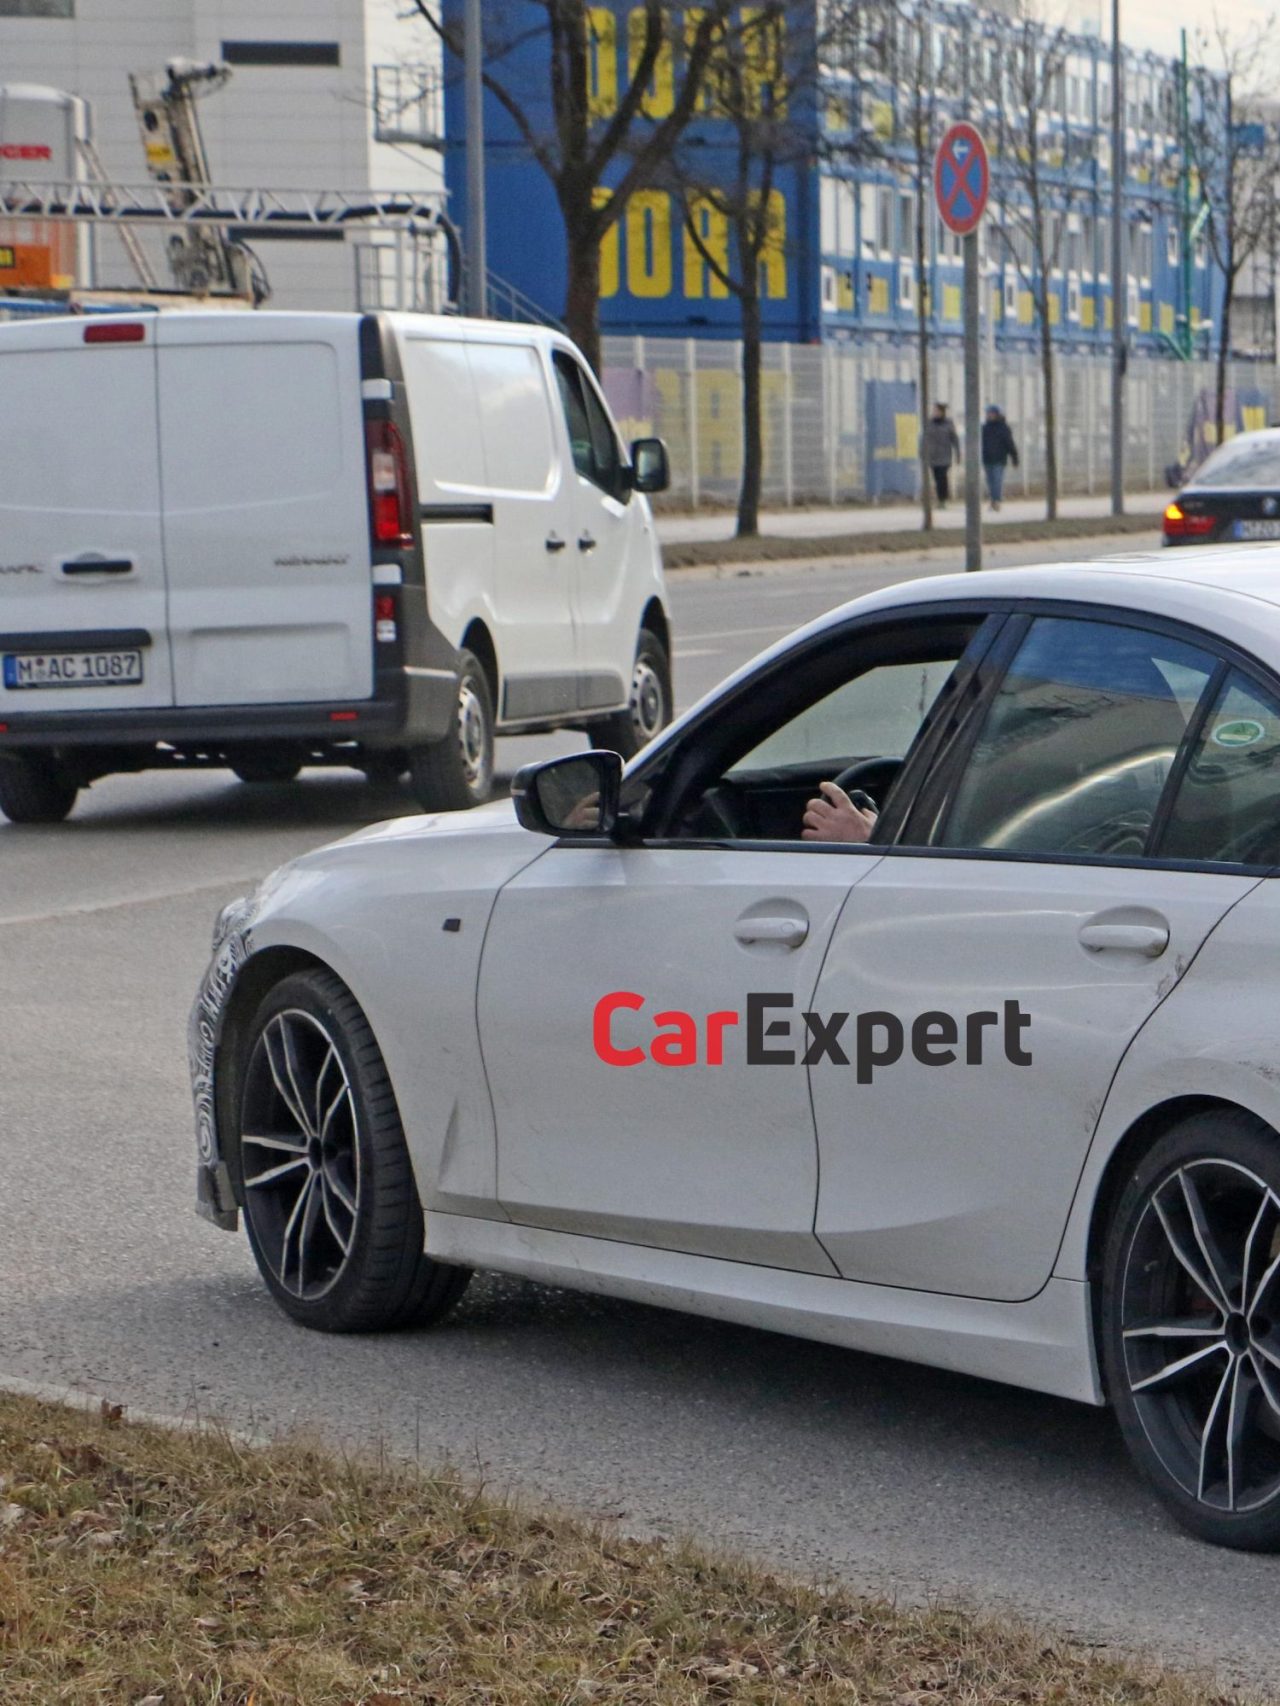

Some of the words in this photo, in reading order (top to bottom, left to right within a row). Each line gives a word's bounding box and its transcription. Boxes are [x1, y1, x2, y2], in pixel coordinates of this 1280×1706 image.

[18, 659, 32, 680] M
[48, 657, 76, 678] AC
[82, 654, 136, 678] 1087
